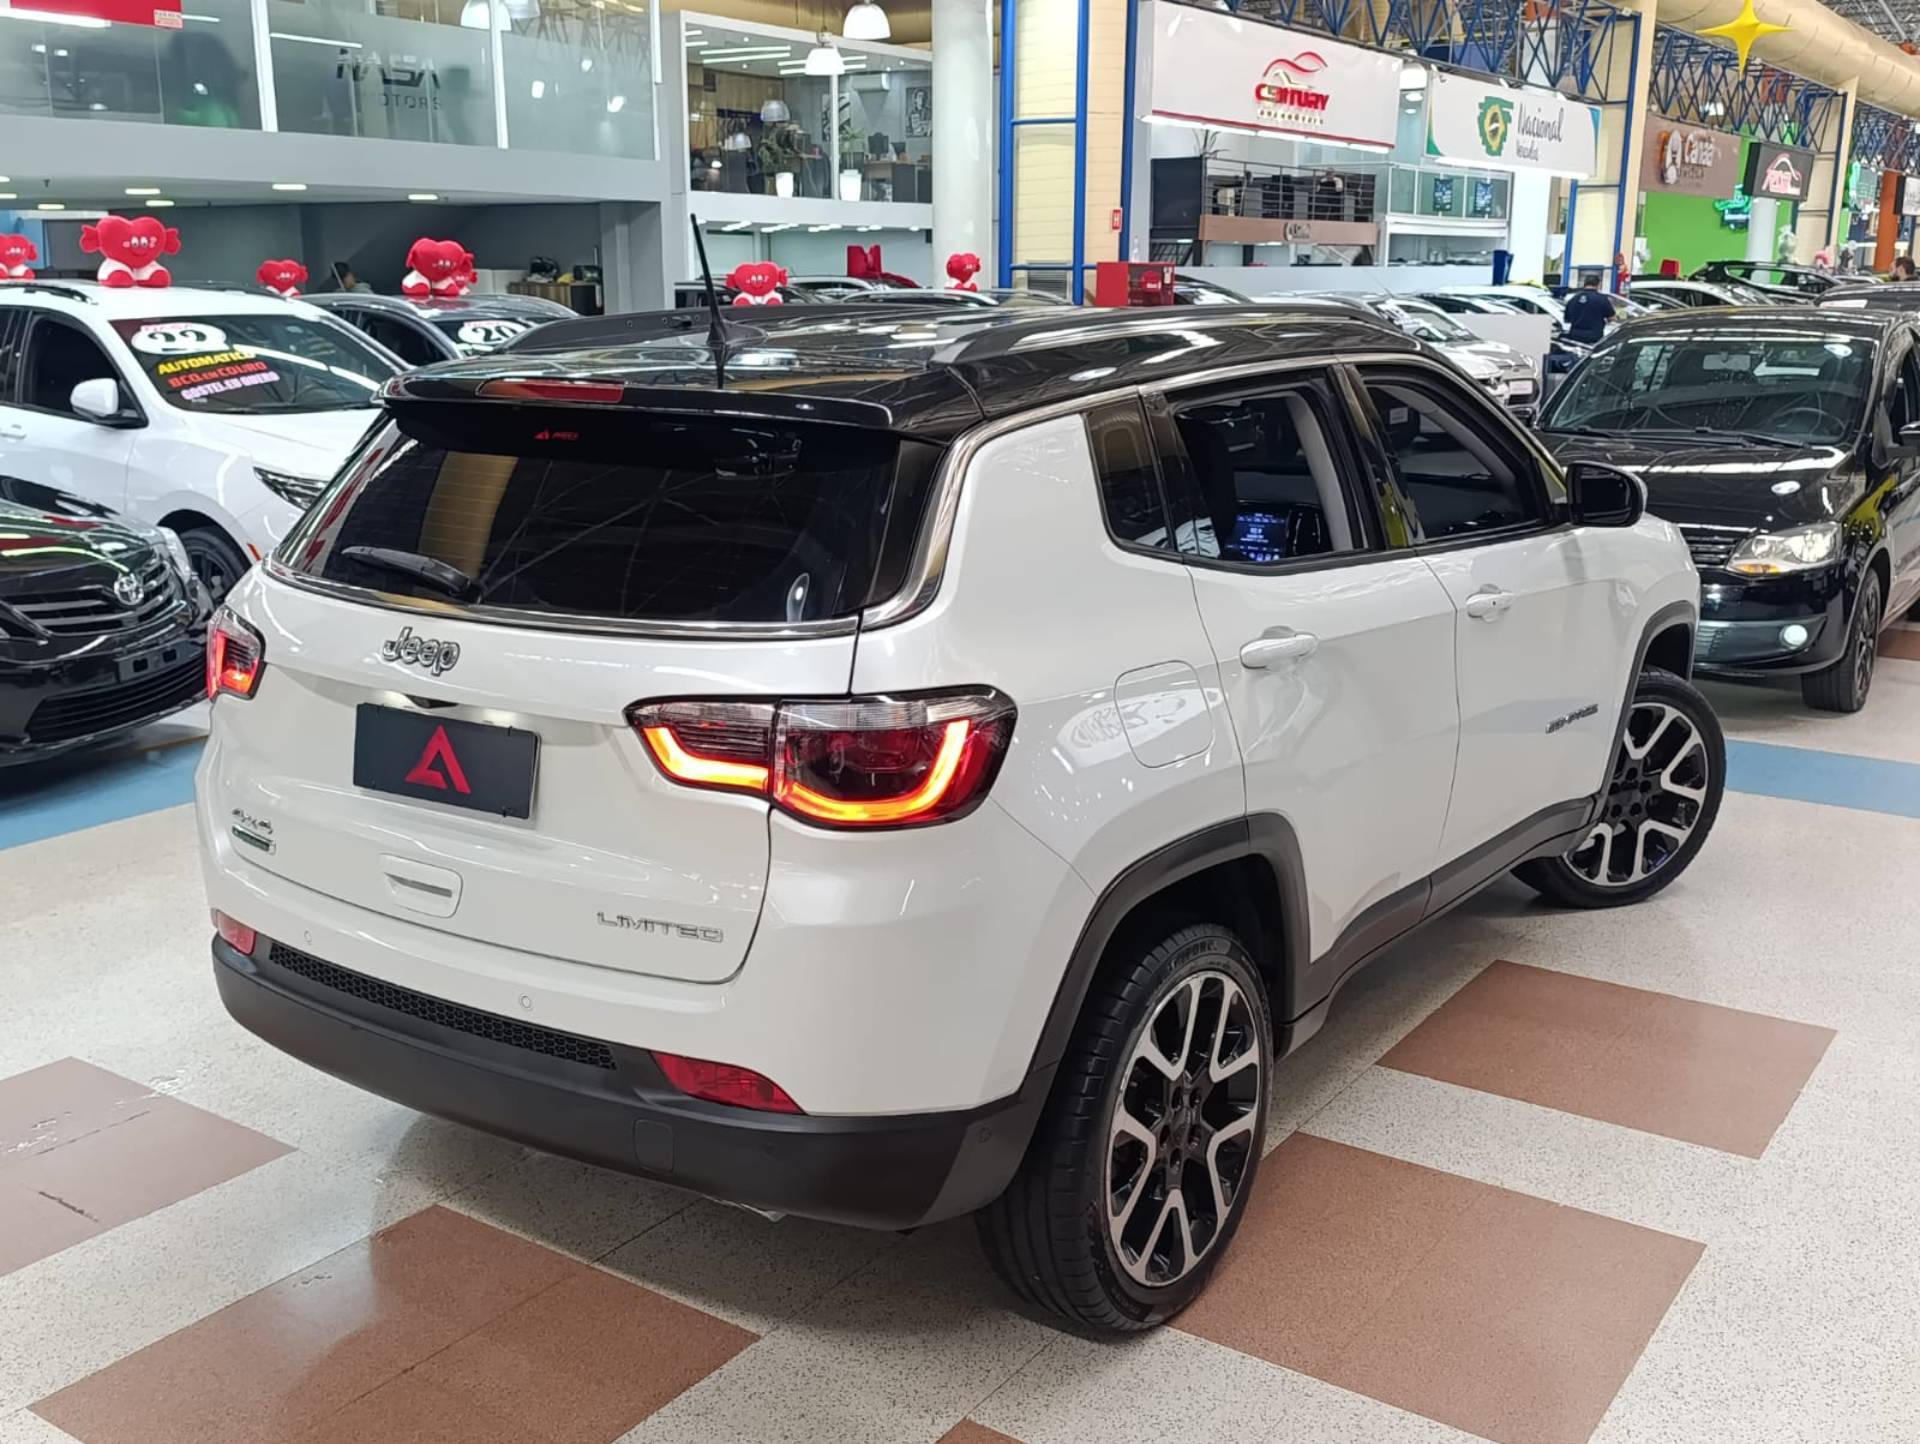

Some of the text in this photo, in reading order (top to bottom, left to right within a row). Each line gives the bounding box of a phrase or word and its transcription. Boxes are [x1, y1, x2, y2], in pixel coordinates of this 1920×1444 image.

[1254, 83, 1331, 111] CENTURY
[1517, 101, 1565, 142] Nacional
[471, 325, 519, 343] 20
[383, 626, 461, 677] Jeep
[596, 910, 724, 944] LIMITED
